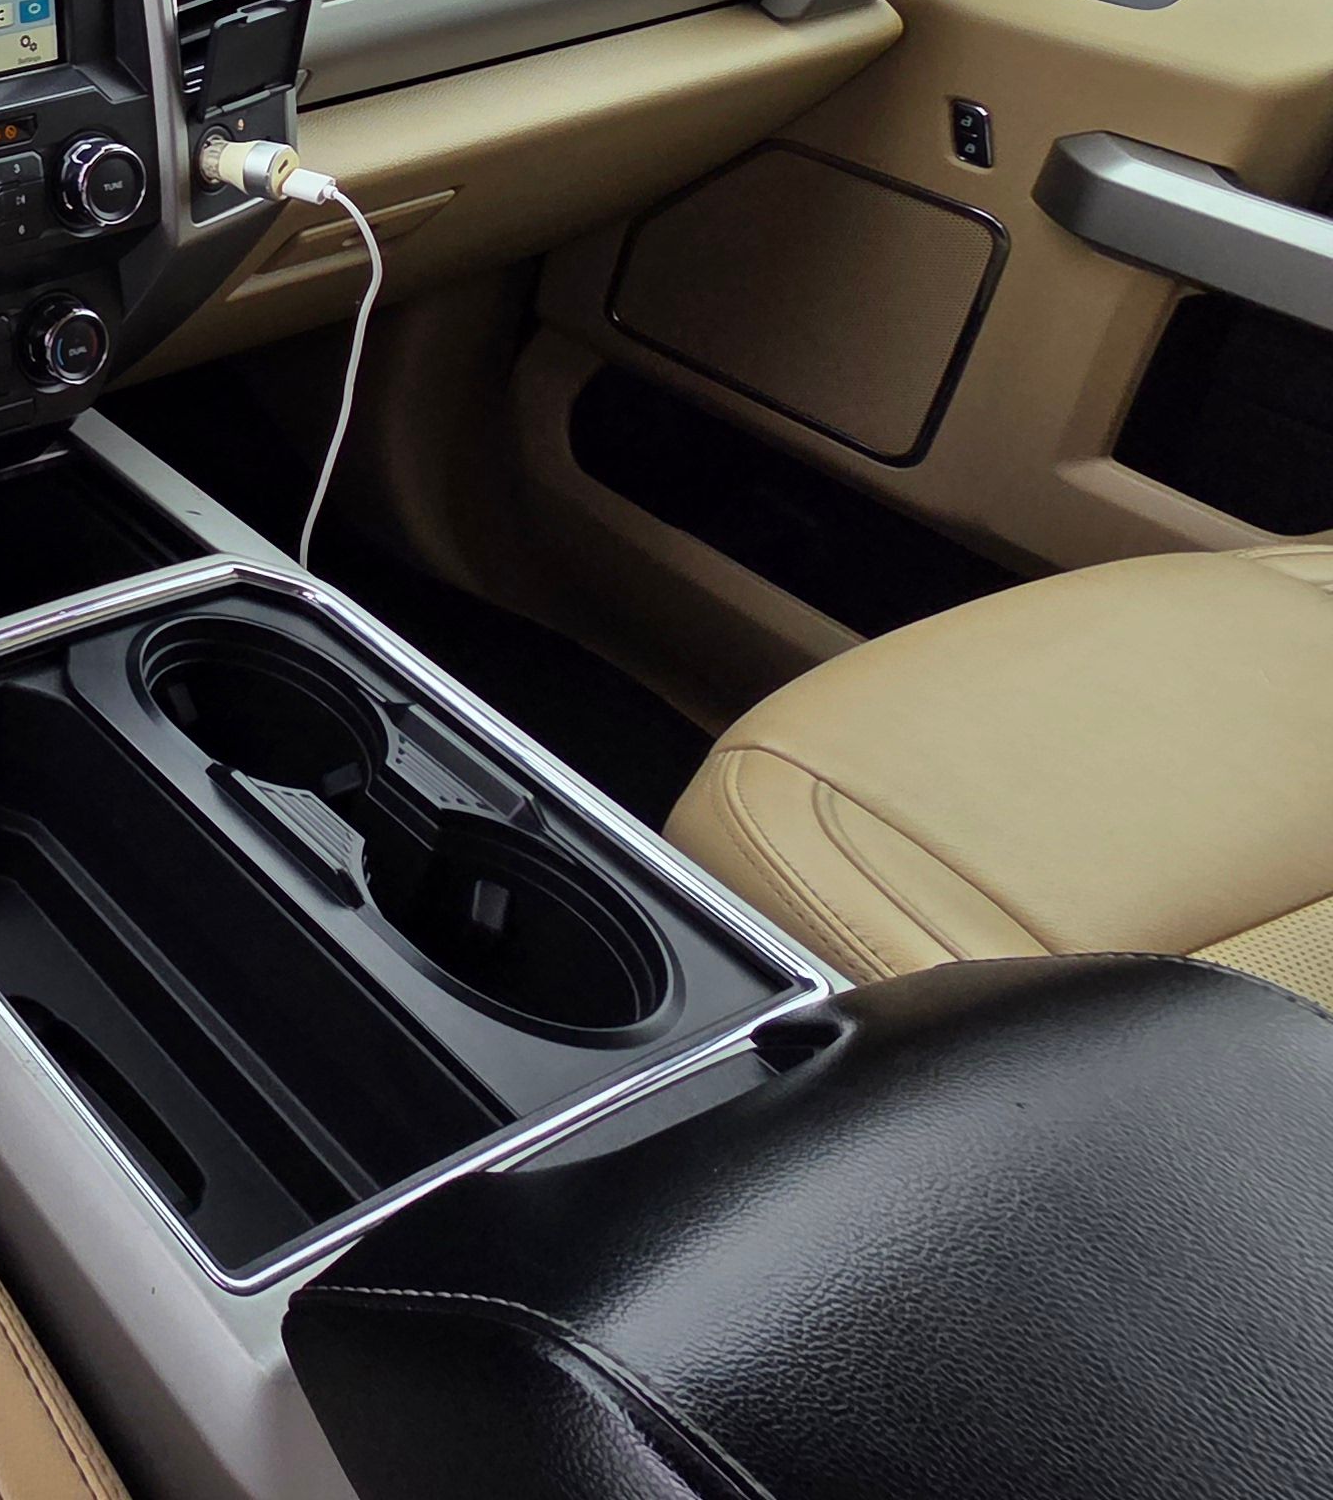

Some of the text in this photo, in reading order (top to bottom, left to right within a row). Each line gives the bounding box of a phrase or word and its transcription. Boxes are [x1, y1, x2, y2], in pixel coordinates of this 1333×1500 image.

[17, 55, 41, 65] Settings
[12, 163, 21, 174] 3
[103, 180, 124, 191] TUNE
[18, 224, 26, 235] 6
[68, 346, 87, 357] DUAL
